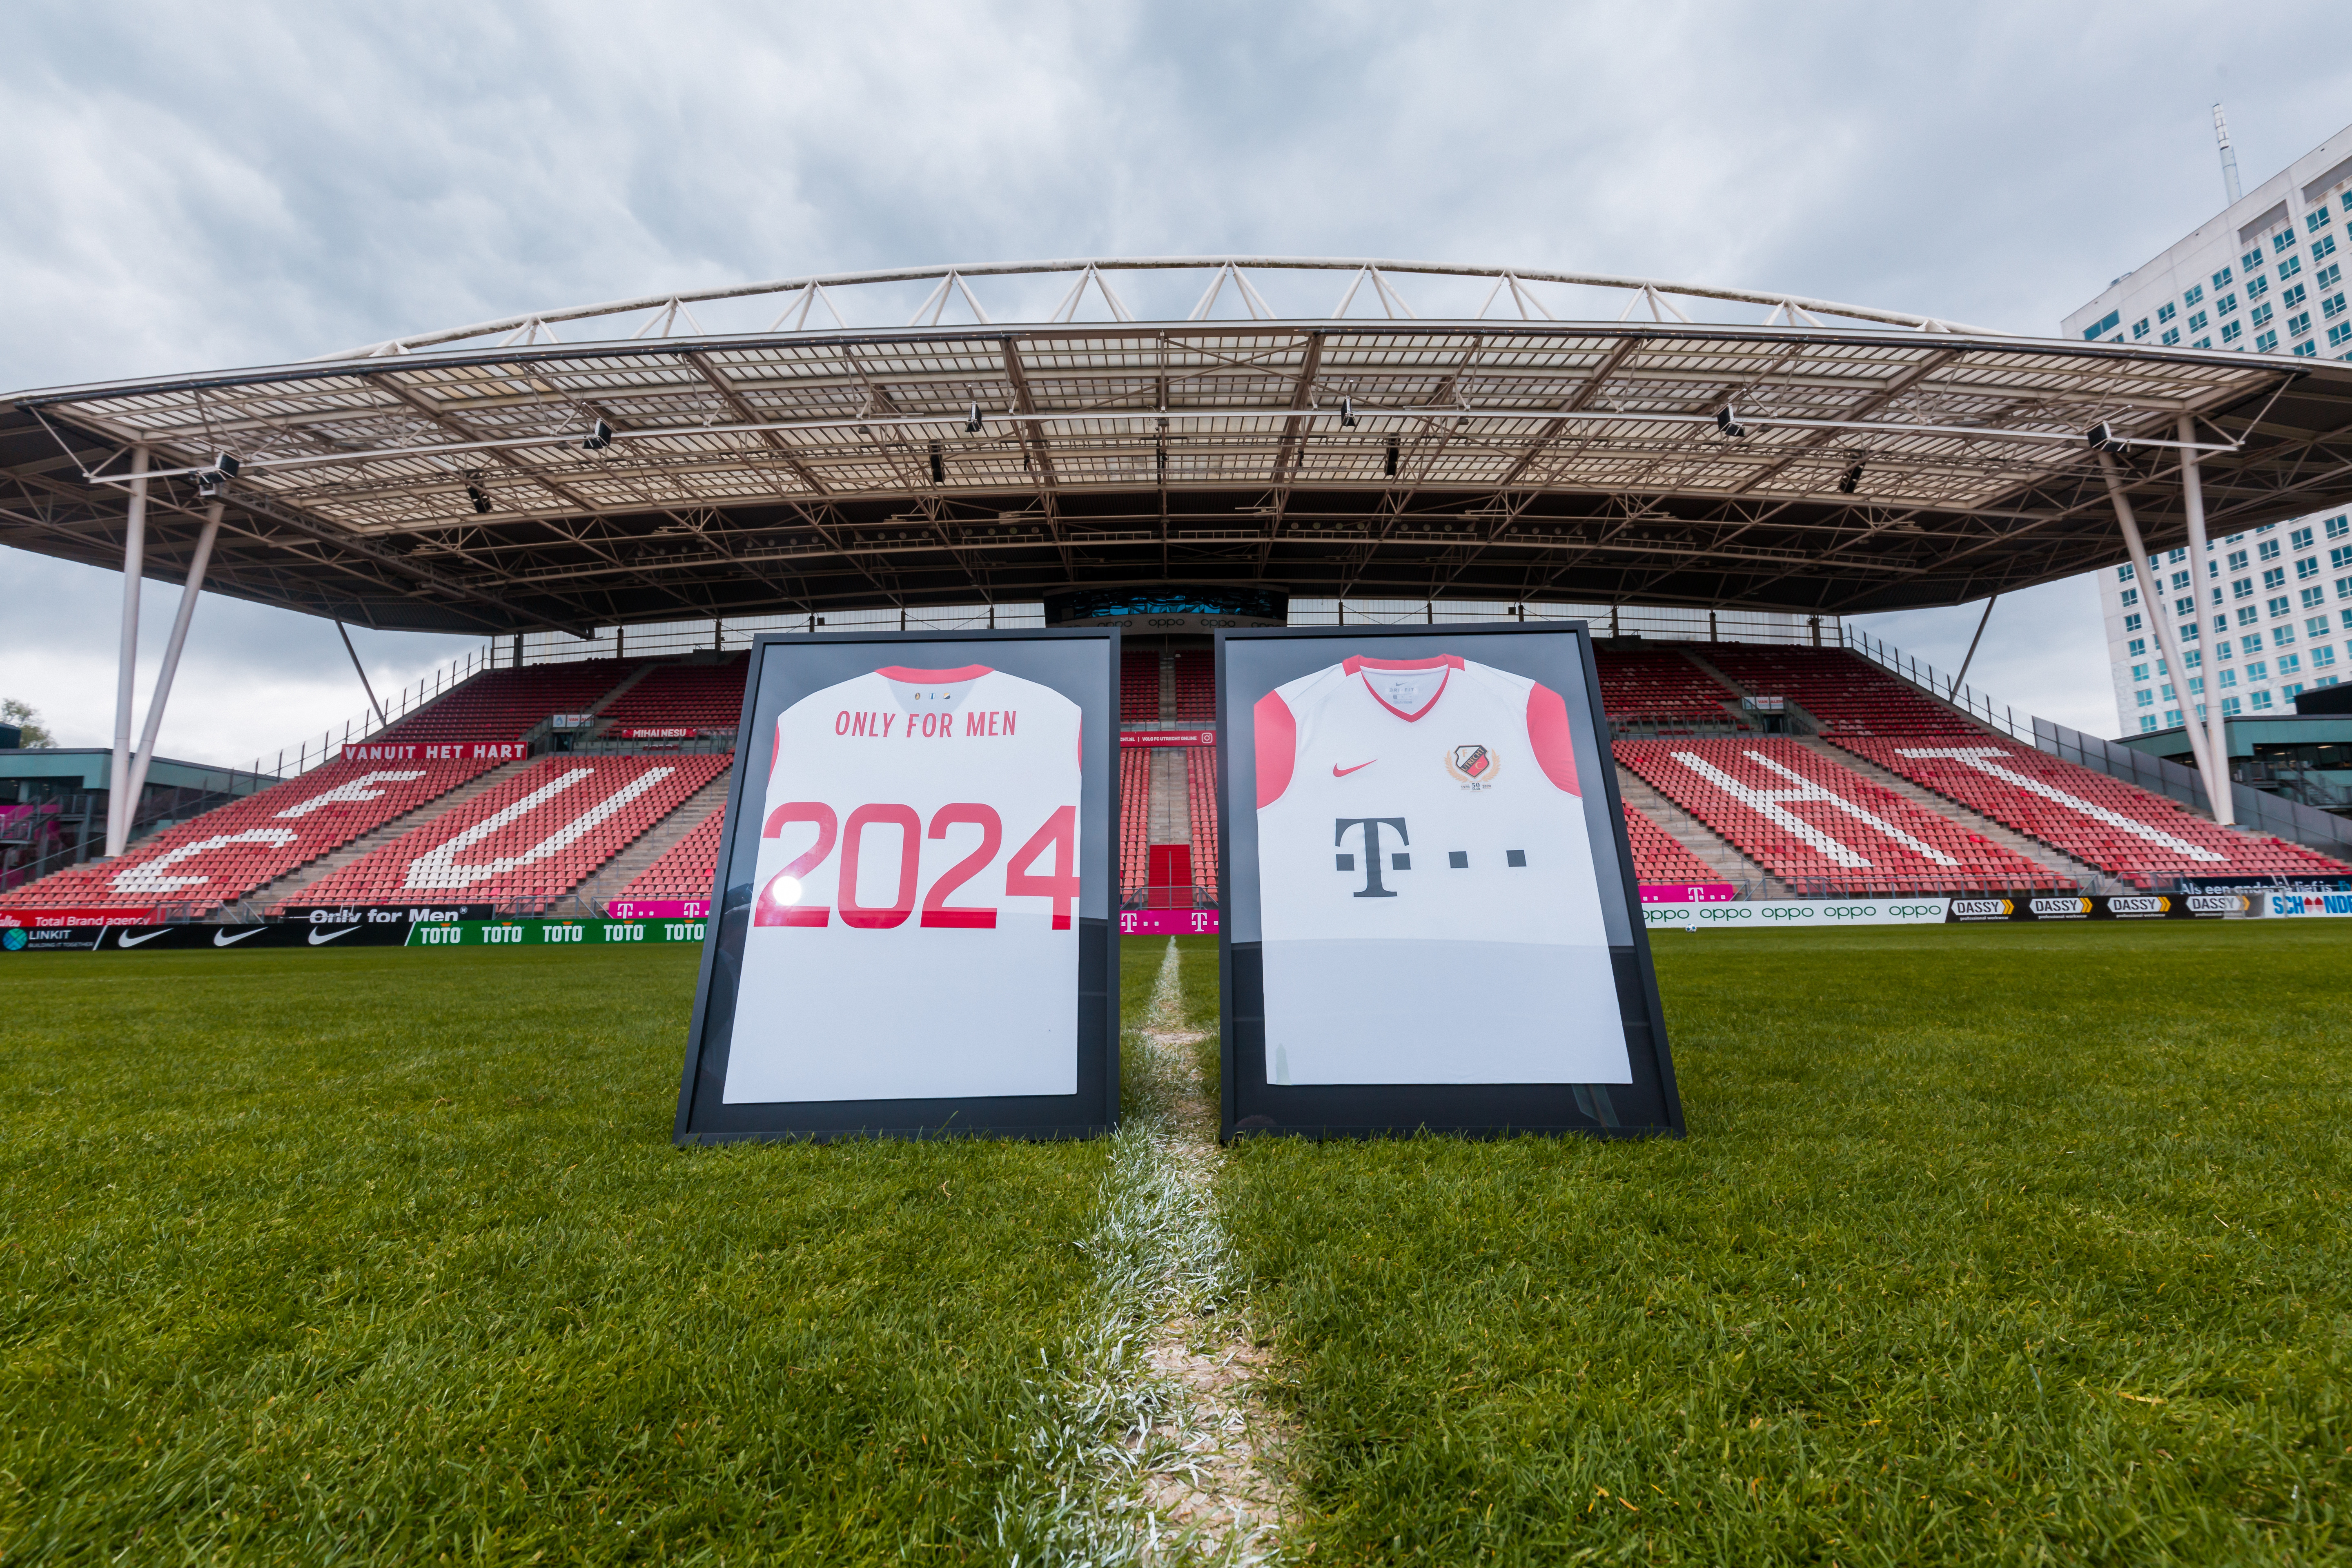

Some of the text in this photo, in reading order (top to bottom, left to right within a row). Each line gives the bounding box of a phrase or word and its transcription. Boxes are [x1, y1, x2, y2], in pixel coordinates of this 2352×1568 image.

[1149, 618, 1184, 628] oppo
[1201, 619, 1236, 628] oppo
[835, 710, 1016, 738] ONLY FOR MEN
[345, 744, 524, 760] VANUIT HET HART
[1461, 748, 1484, 771] UTRECHT
[753, 802, 1080, 930] 2024
[1957, 901, 1999, 913] DASSY
[2036, 900, 2078, 911] DASSY
[2113, 899, 2156, 910] DASSY
[2192, 898, 2235, 909] DASSY
[310, 910, 362, 923] Only
[368, 909, 402, 922] for
[409, 909, 459, 922] Men
[1643, 909, 1690, 922] oppo
[1700, 909, 1752, 921] oppo
[1762, 908, 1814, 920] oppo
[1824, 906, 1876, 919] oppo
[1889, 905, 1941, 918] oppo
[35, 916, 65, 926] Total
[67, 916, 104, 926] Brand
[29, 930, 72, 940] LINKIT
[420, 927, 461, 944] TOTO
[482, 926, 522, 943] TOTO
[542, 925, 583, 942] TOTO
[604, 924, 644, 941] TOTO
[664, 924, 704, 940] TOTO
